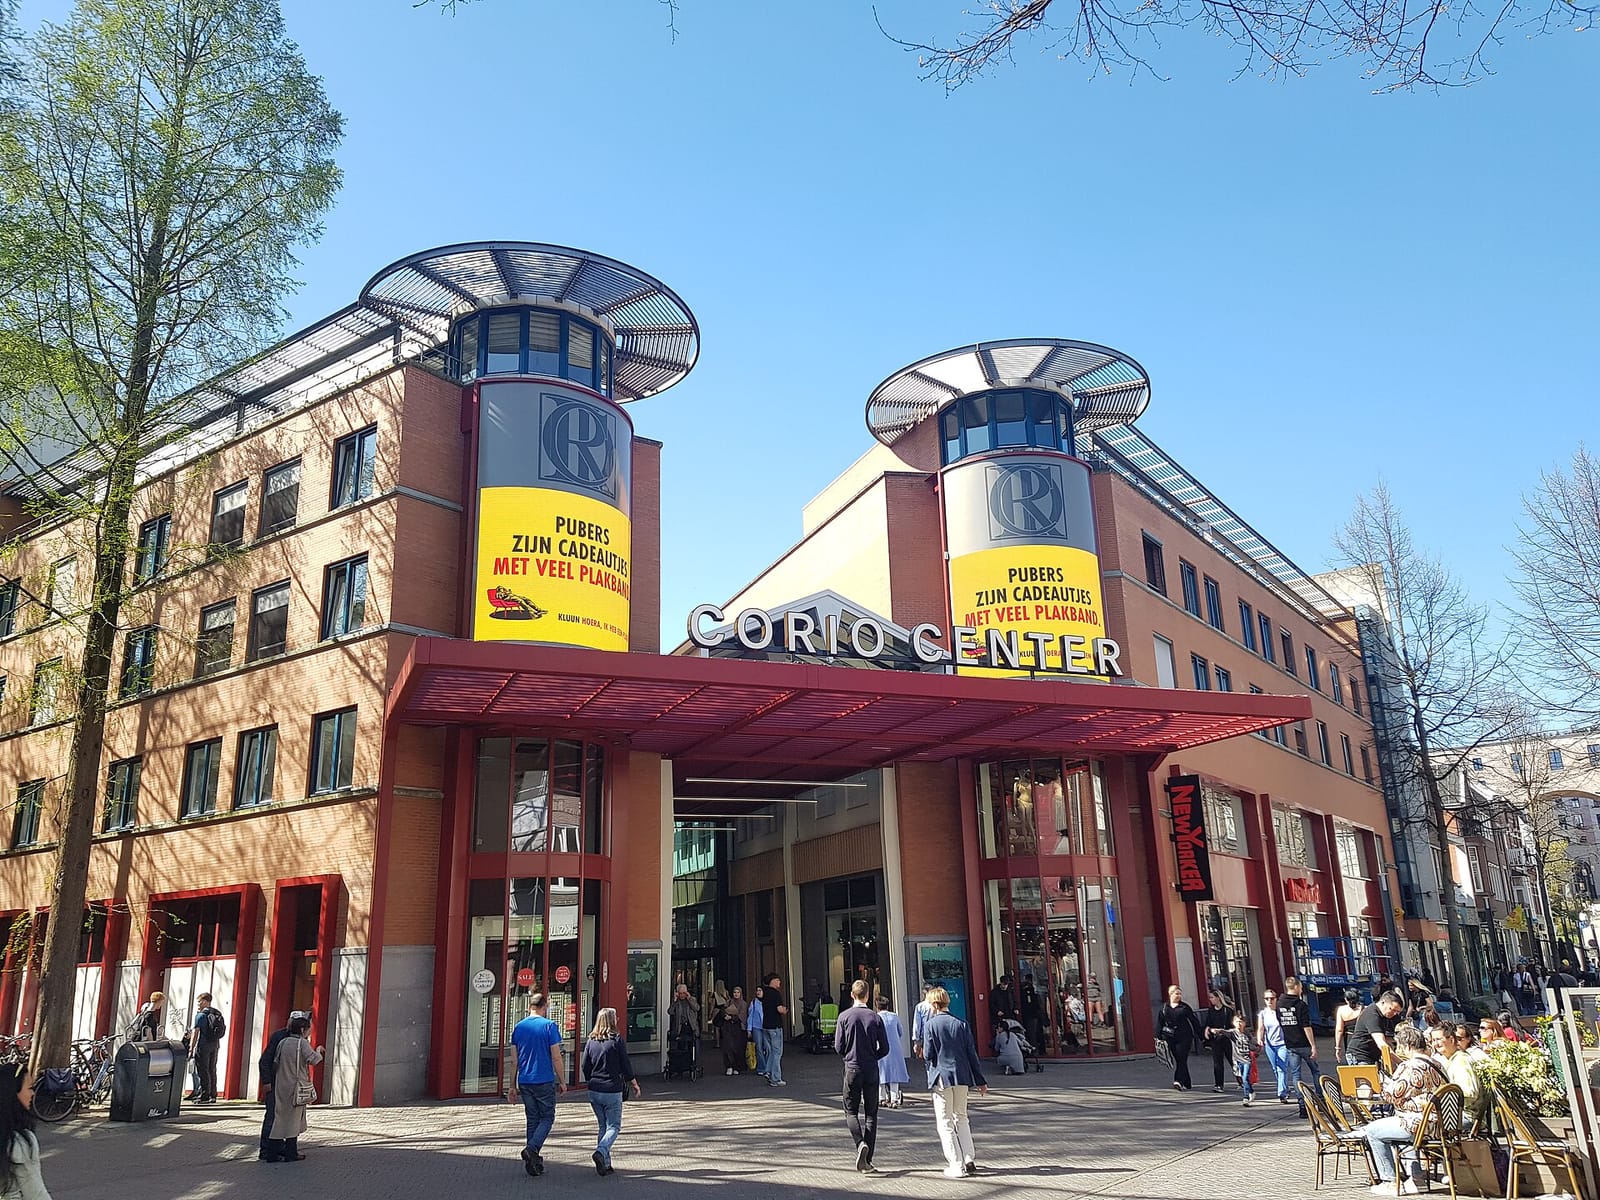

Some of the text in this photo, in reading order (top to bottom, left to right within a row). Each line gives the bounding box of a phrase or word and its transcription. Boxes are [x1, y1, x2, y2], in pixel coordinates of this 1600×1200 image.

[555, 515, 610, 546] PUBERS
[511, 534, 629, 578] ZIJN CADEAUTJES
[493, 557, 530, 576] MET
[535, 558, 575, 581] VEEL
[1008, 566, 1064, 583] PUBERS
[975, 585, 1092, 608] ZIJN CADEAUTJES
[557, 612, 581, 625] KLUUN
[965, 603, 1101, 628] MET VEEL PLAKBAND.
[687, 603, 1124, 677] CORIO CENTER
